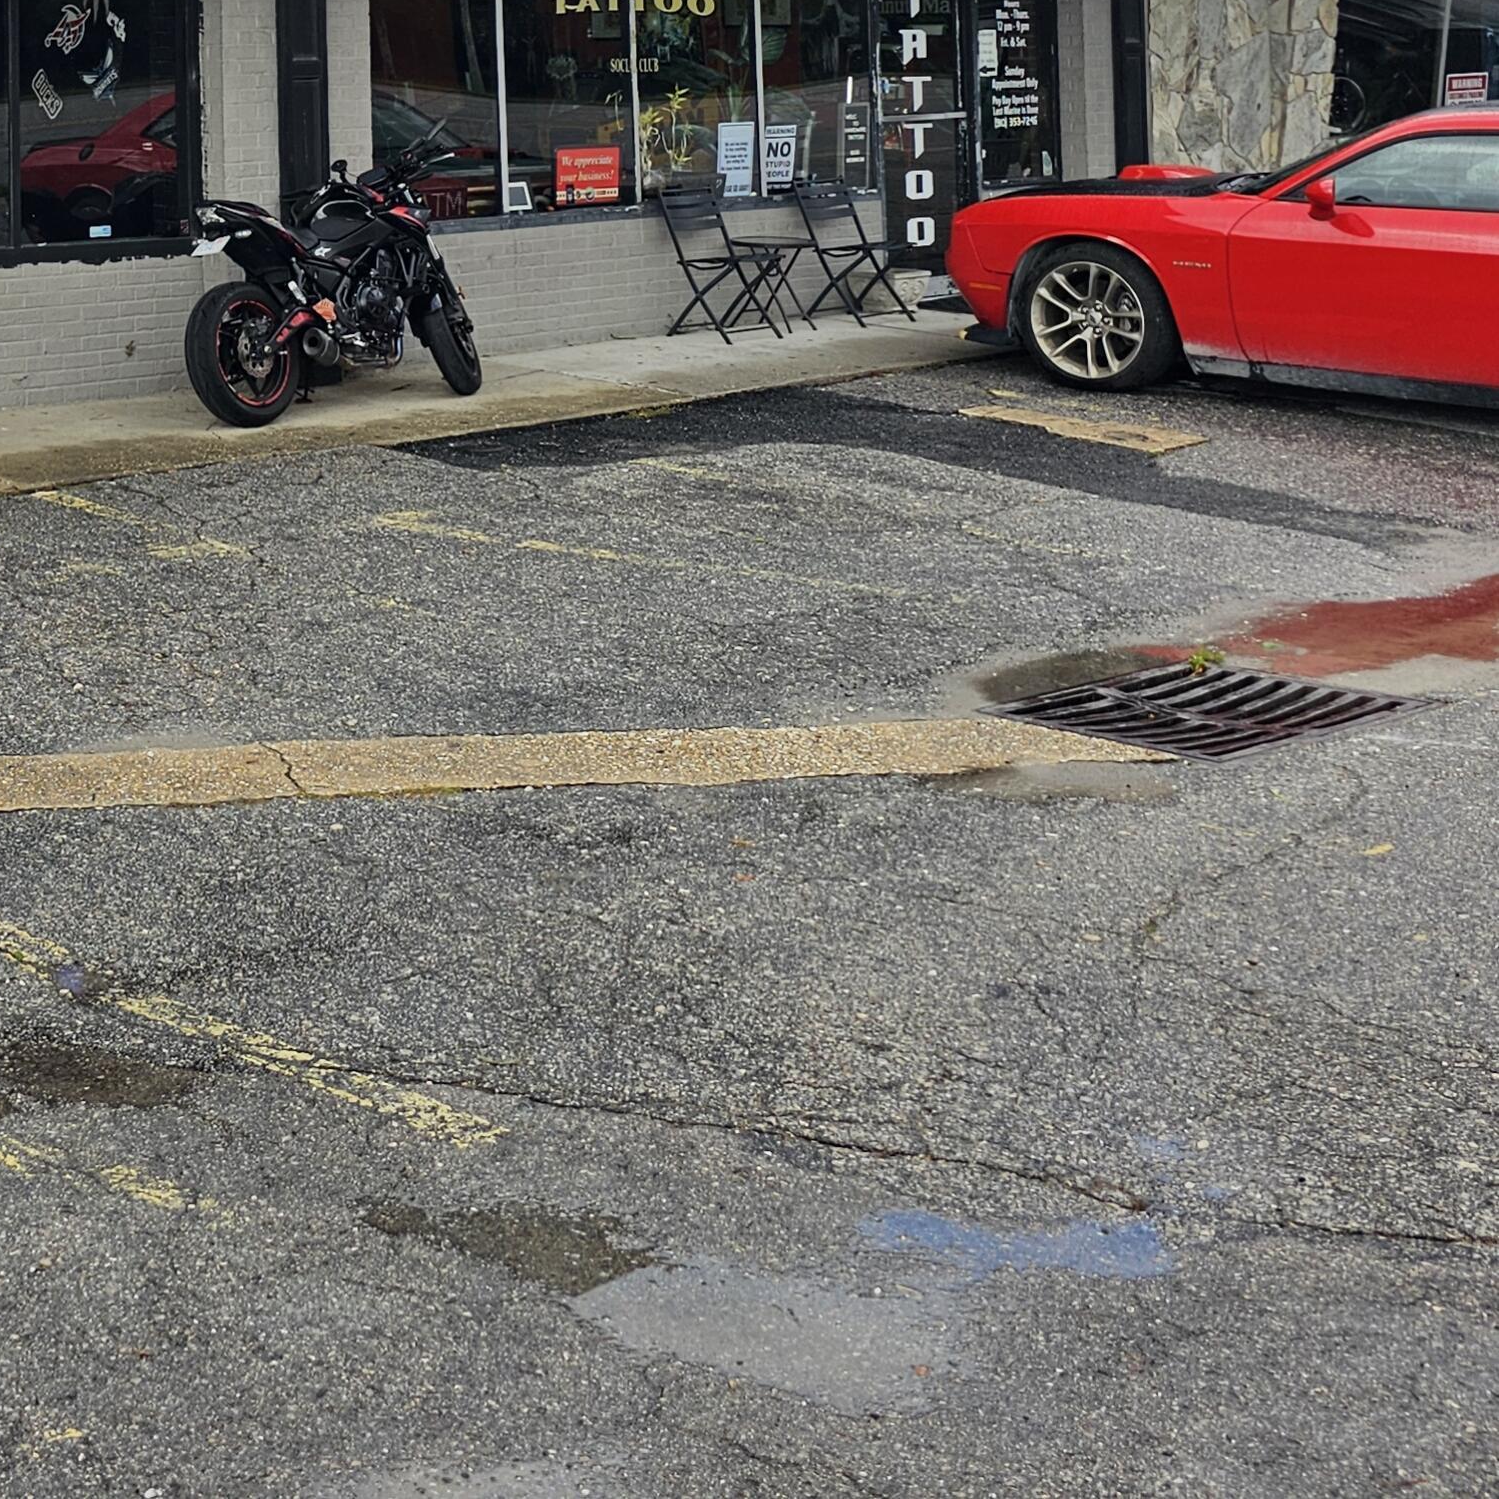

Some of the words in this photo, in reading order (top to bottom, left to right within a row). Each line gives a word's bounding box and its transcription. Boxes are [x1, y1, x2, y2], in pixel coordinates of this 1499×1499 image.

[638, 57, 659, 72] CLUB
[1004, 66, 1025, 78] Sunday
[35, 73, 61, 115] BUCKS
[766, 141, 791, 158] NO
[574, 155, 613, 168] appreciate
[765, 160, 791, 168] STUPID
[558, 174, 577, 185] your
[578, 170, 614, 181] business!
[426, 191, 463, 217] TM
